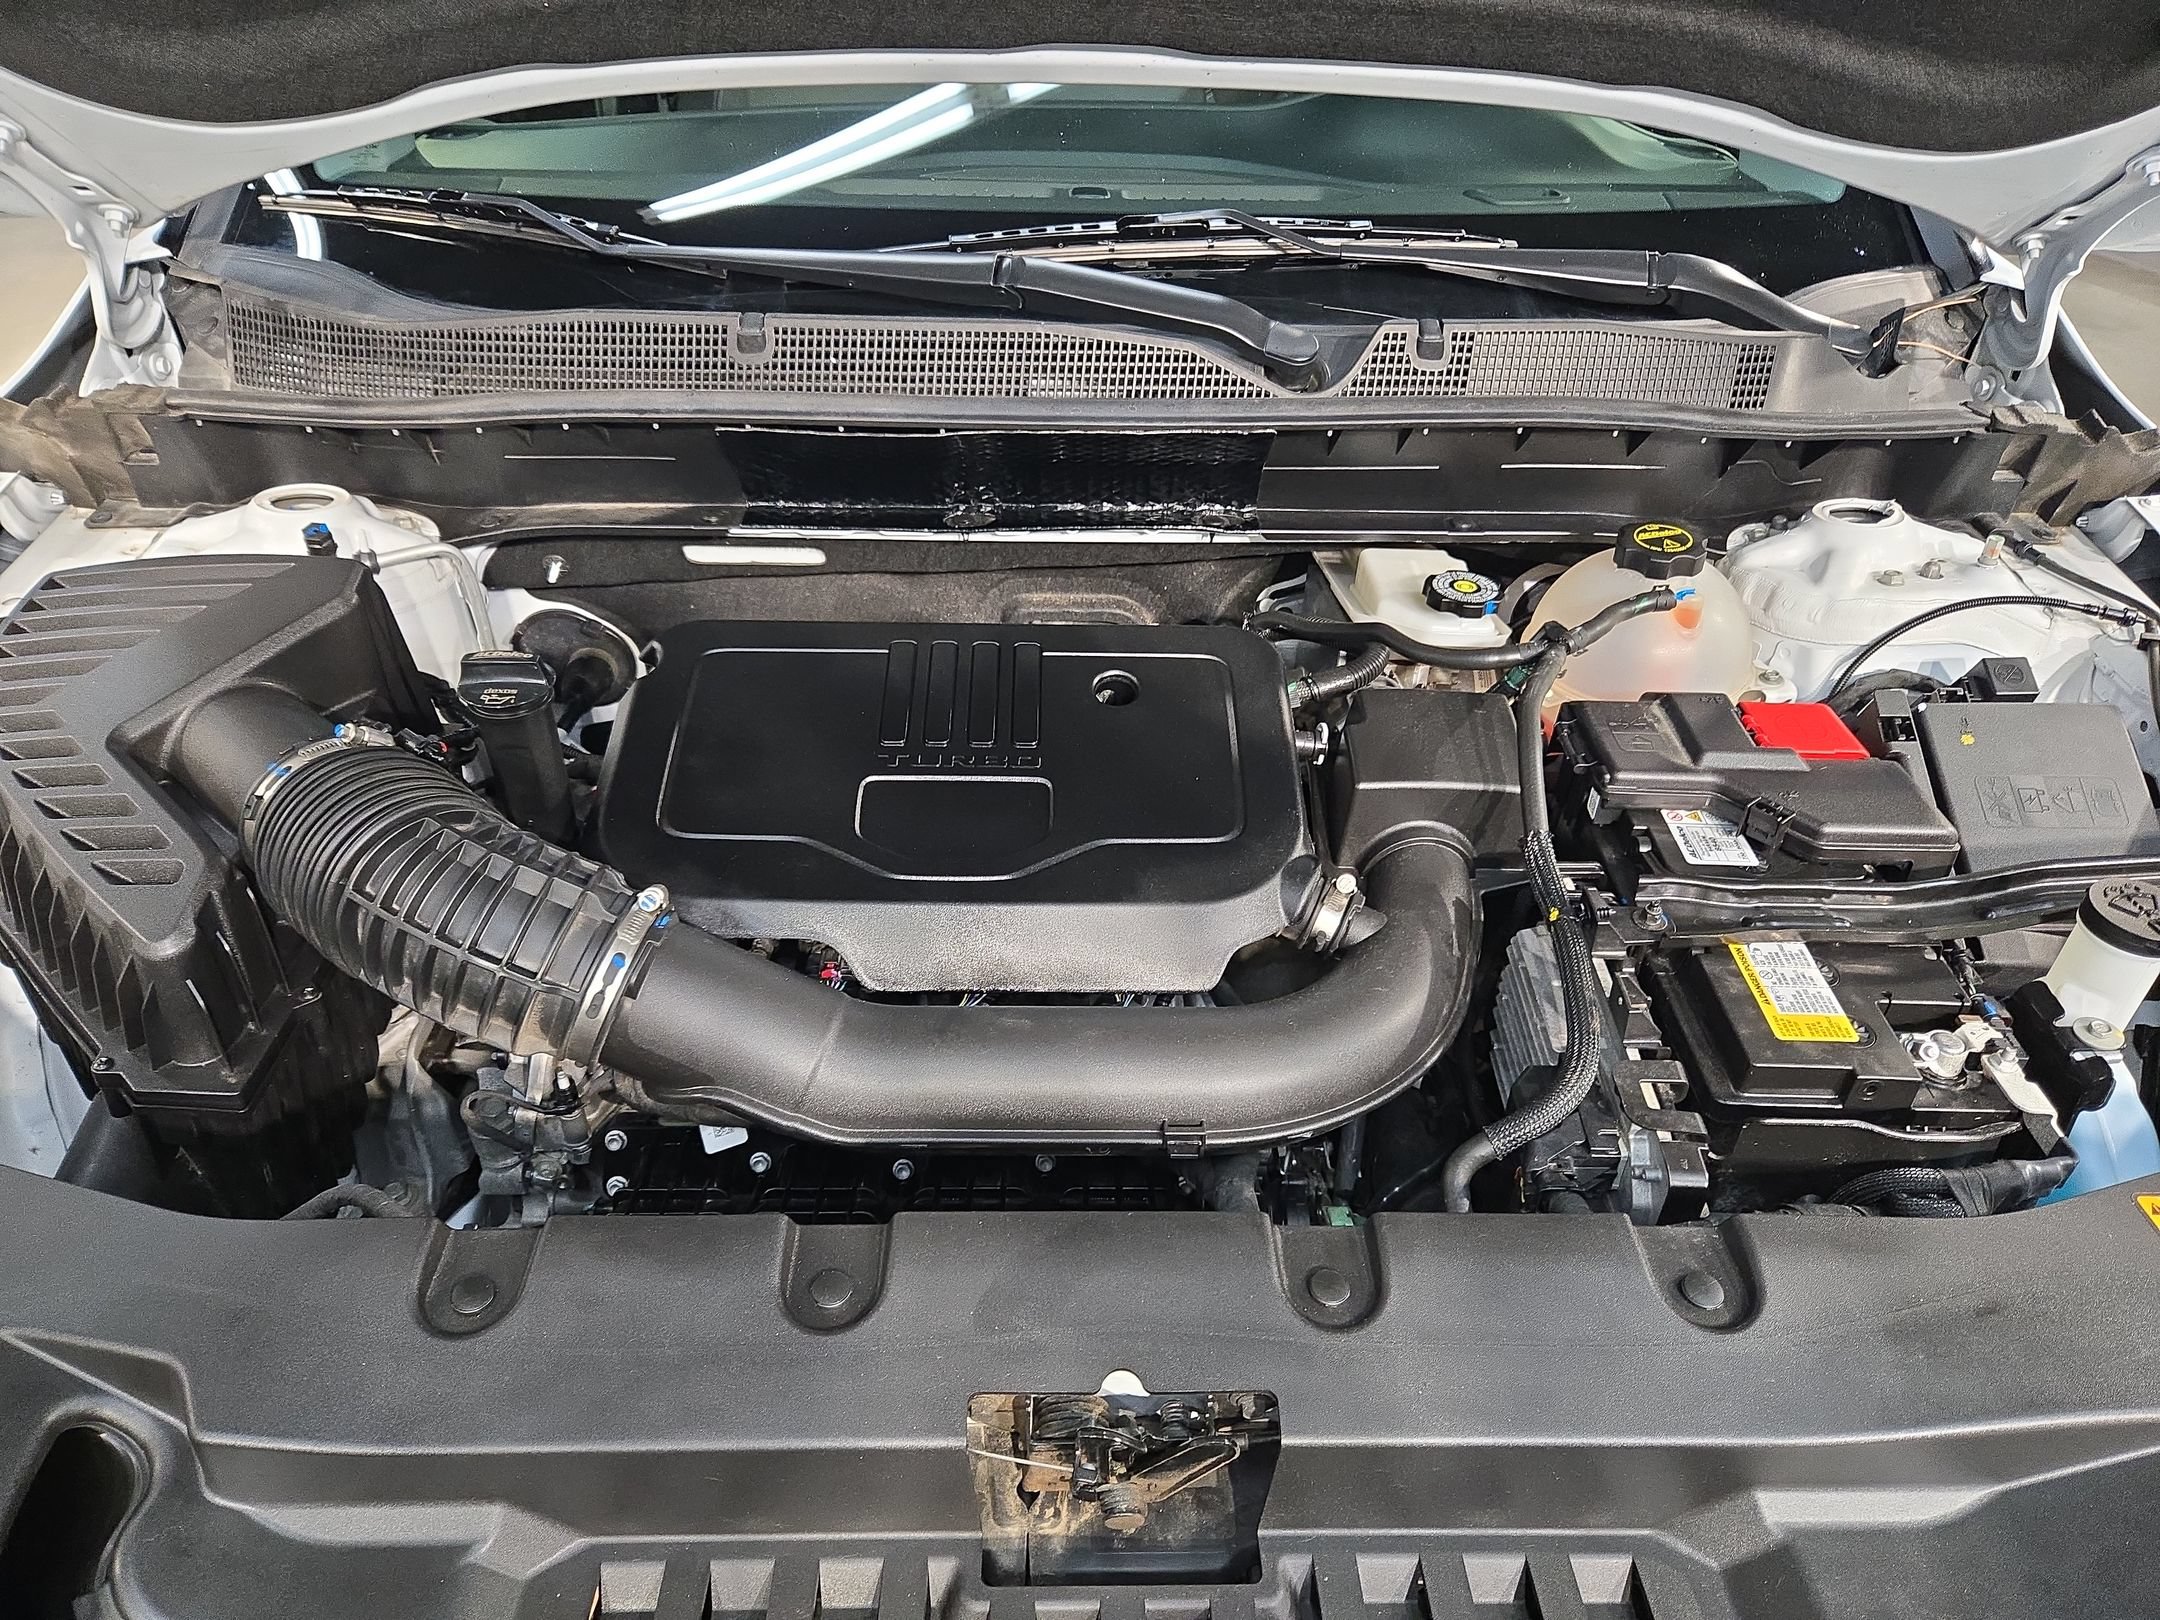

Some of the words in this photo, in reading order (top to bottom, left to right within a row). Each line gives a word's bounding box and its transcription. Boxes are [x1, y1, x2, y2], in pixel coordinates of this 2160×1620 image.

[471, 650, 534, 660] ACDelco
[483, 687, 519, 695] dexos
[876, 753, 1043, 769] TURBO
[1676, 825, 1699, 860] ACDelco
[1734, 947, 1753, 971] POISON
[1747, 972, 1768, 999] DANGER
